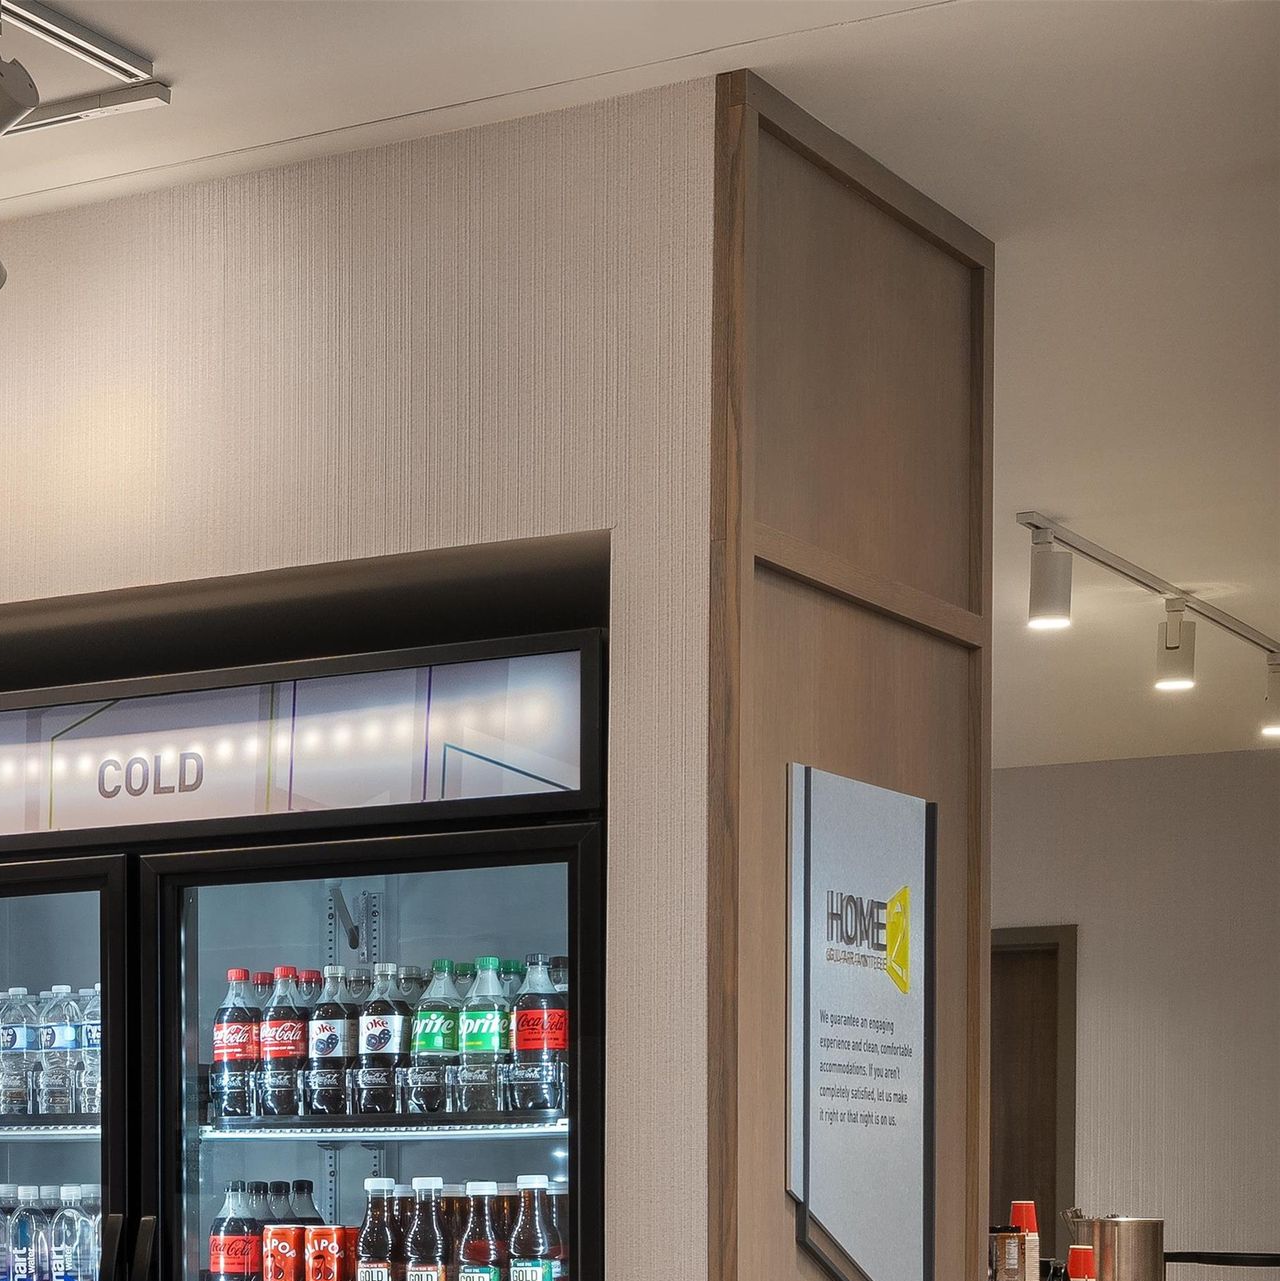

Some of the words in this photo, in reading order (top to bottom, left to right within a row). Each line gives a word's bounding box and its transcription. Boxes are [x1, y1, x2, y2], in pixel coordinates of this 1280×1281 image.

[97, 751, 205, 800] COLD
[826, 890, 887, 952] HOME
[819, 1008, 829, 1024] We
[830, 1012, 860, 1028] guarantee
[860, 1017, 868, 1029] an
[869, 1018, 894, 1036] engaging
[820, 1035, 851, 1052] experience
[851, 1039, 862, 1052] and
[863, 1039, 879, 1056] clean,
[880, 1042, 913, 1058] comfortable
[820, 1060, 867, 1076] accommodations.
[868, 1063, 873, 1077] If
[873, 1066, 884, 1080] you
[884, 1066, 900, 1080] aren't
[820, 1083, 850, 1102] completely
[850, 1086, 876, 1103] satisfied,
[885, 1091, 892, 1103] us
[892, 1090, 908, 1104] make
[819, 1106, 824, 1121] it
[824, 1107, 839, 1125] right
[840, 1111, 846, 1122] or
[846, 1108, 858, 1123] that
[859, 1109, 874, 1128] night
[874, 1111, 880, 1125] is
[880, 1115, 887, 1126] on
[888, 1114, 897, 1127] us.
